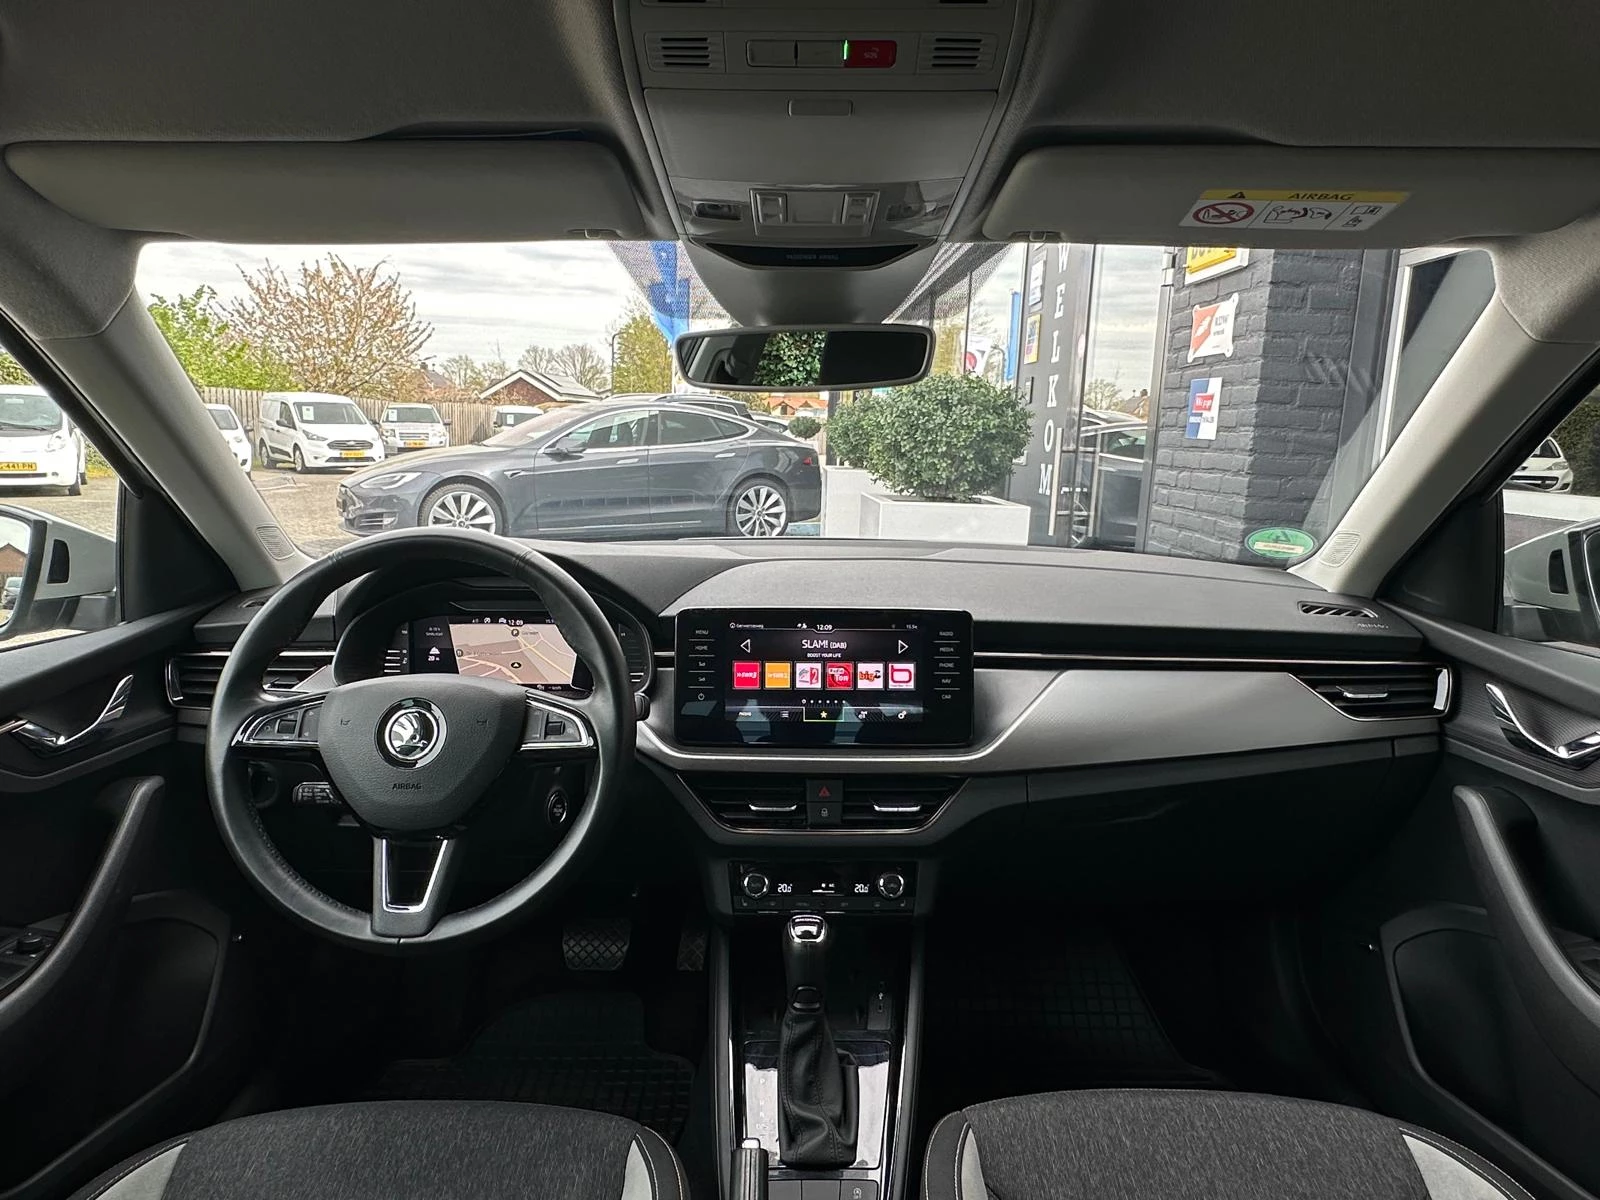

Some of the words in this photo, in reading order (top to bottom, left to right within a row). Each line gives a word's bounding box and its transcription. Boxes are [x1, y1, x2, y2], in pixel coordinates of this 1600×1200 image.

[1288, 192, 1355, 201] AIRBAG
[801, 639, 829, 650] SLAM!
[829, 641, 848, 650] (DAB)
[391, 782, 422, 790] AIRBAG
